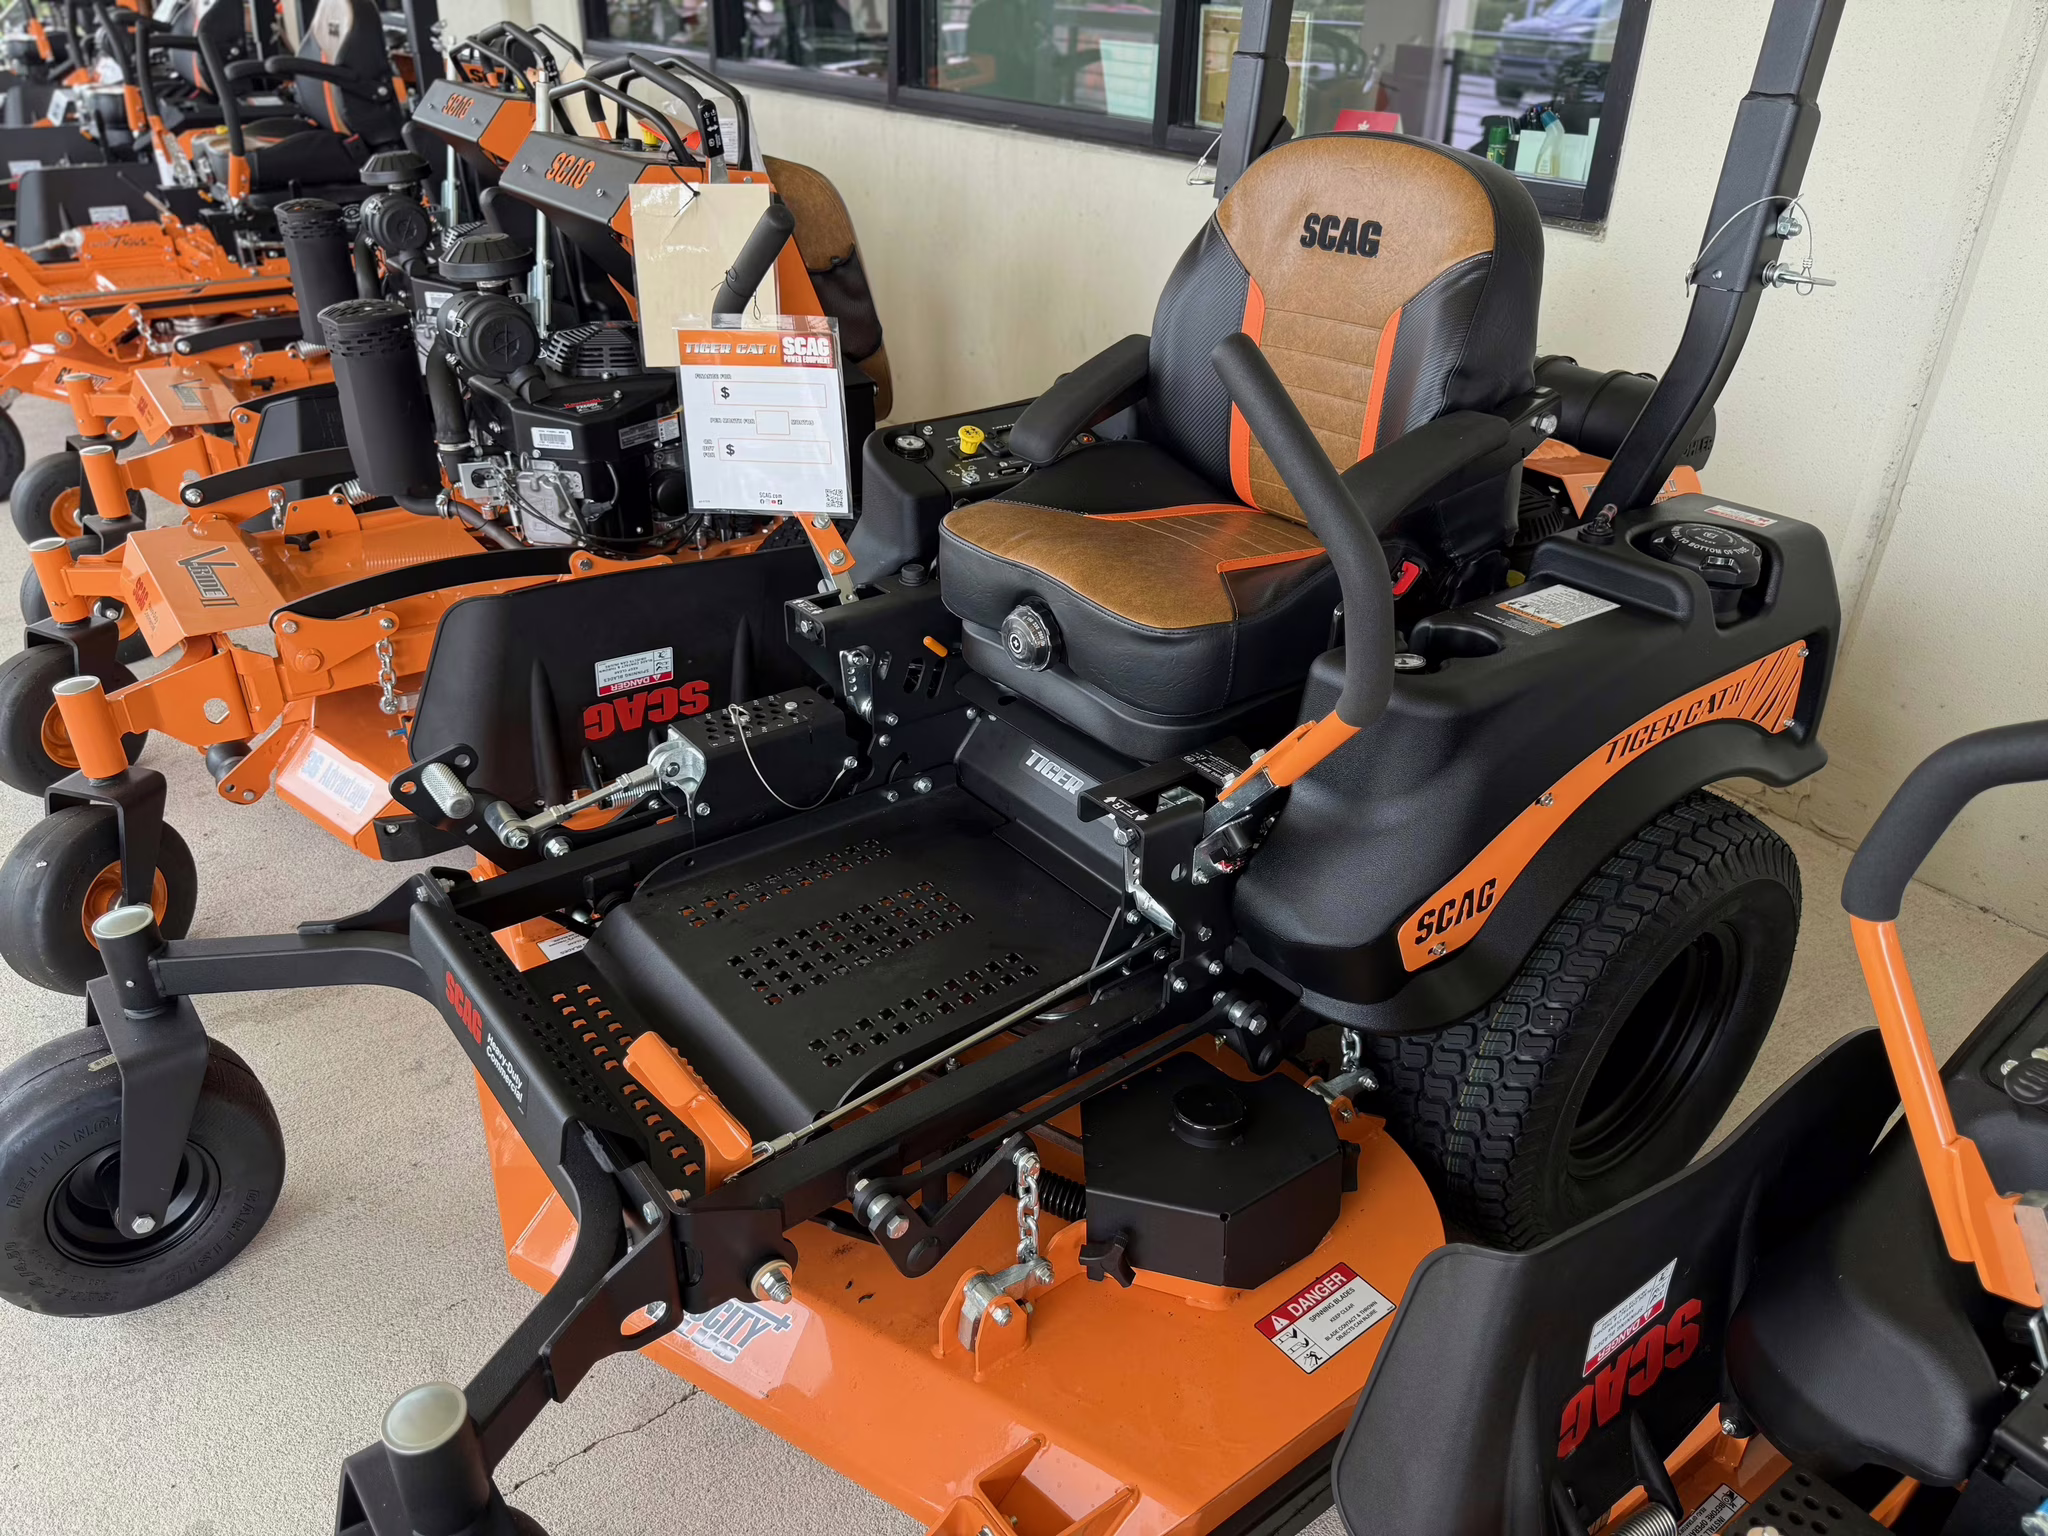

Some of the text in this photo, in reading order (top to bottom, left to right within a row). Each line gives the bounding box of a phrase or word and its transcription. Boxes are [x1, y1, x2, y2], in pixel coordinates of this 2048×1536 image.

[442, 93, 475, 120] SCAG
[545, 152, 596, 190] SCAG
[1300, 212, 1382, 258] SCAG
[684, 342, 732, 355] TIGER
[735, 343, 764, 355] CAT
[781, 337, 830, 356] SCAG
[784, 355, 831, 364] POWER EQUIPMENT
[720, 386, 730, 399] $
[726, 444, 735, 456] $
[1688, 542, 1722, 554] BOTTOM
[603, 668, 649, 683] SPINNING BLADES
[610, 676, 650, 691] DANGER
[583, 680, 709, 740] SCAG
[1605, 709, 1683, 765] TIGER
[1684, 685, 1734, 726] CAT
[1025, 749, 1085, 795] TIGER
[1414, 877, 1497, 945] SCAG
[445, 971, 483, 1045] SCAG
[486, 1045, 523, 1103] Commercial
[487, 1033, 523, 1089] Heavy-Duty
[1287, 1271, 1347, 1318] DANGER
[1308, 1287, 1355, 1323] SPINNING BLADES
[1324, 1328, 1340, 1342] BLADE
[1339, 1316, 1357, 1332] CONTACT
[1360, 1300, 1378, 1315] THROWN
[1330, 1303, 1355, 1323] KEEP CLEAR
[1336, 1309, 1378, 1342] OBJECTS CAN INJURE
[1598, 1319, 1639, 1361] DANGER
[1557, 1298, 1702, 1459] SCAG
[1703, 1515, 1725, 1536] INSTALL
[1705, 1502, 1725, 1522] BEFORE
